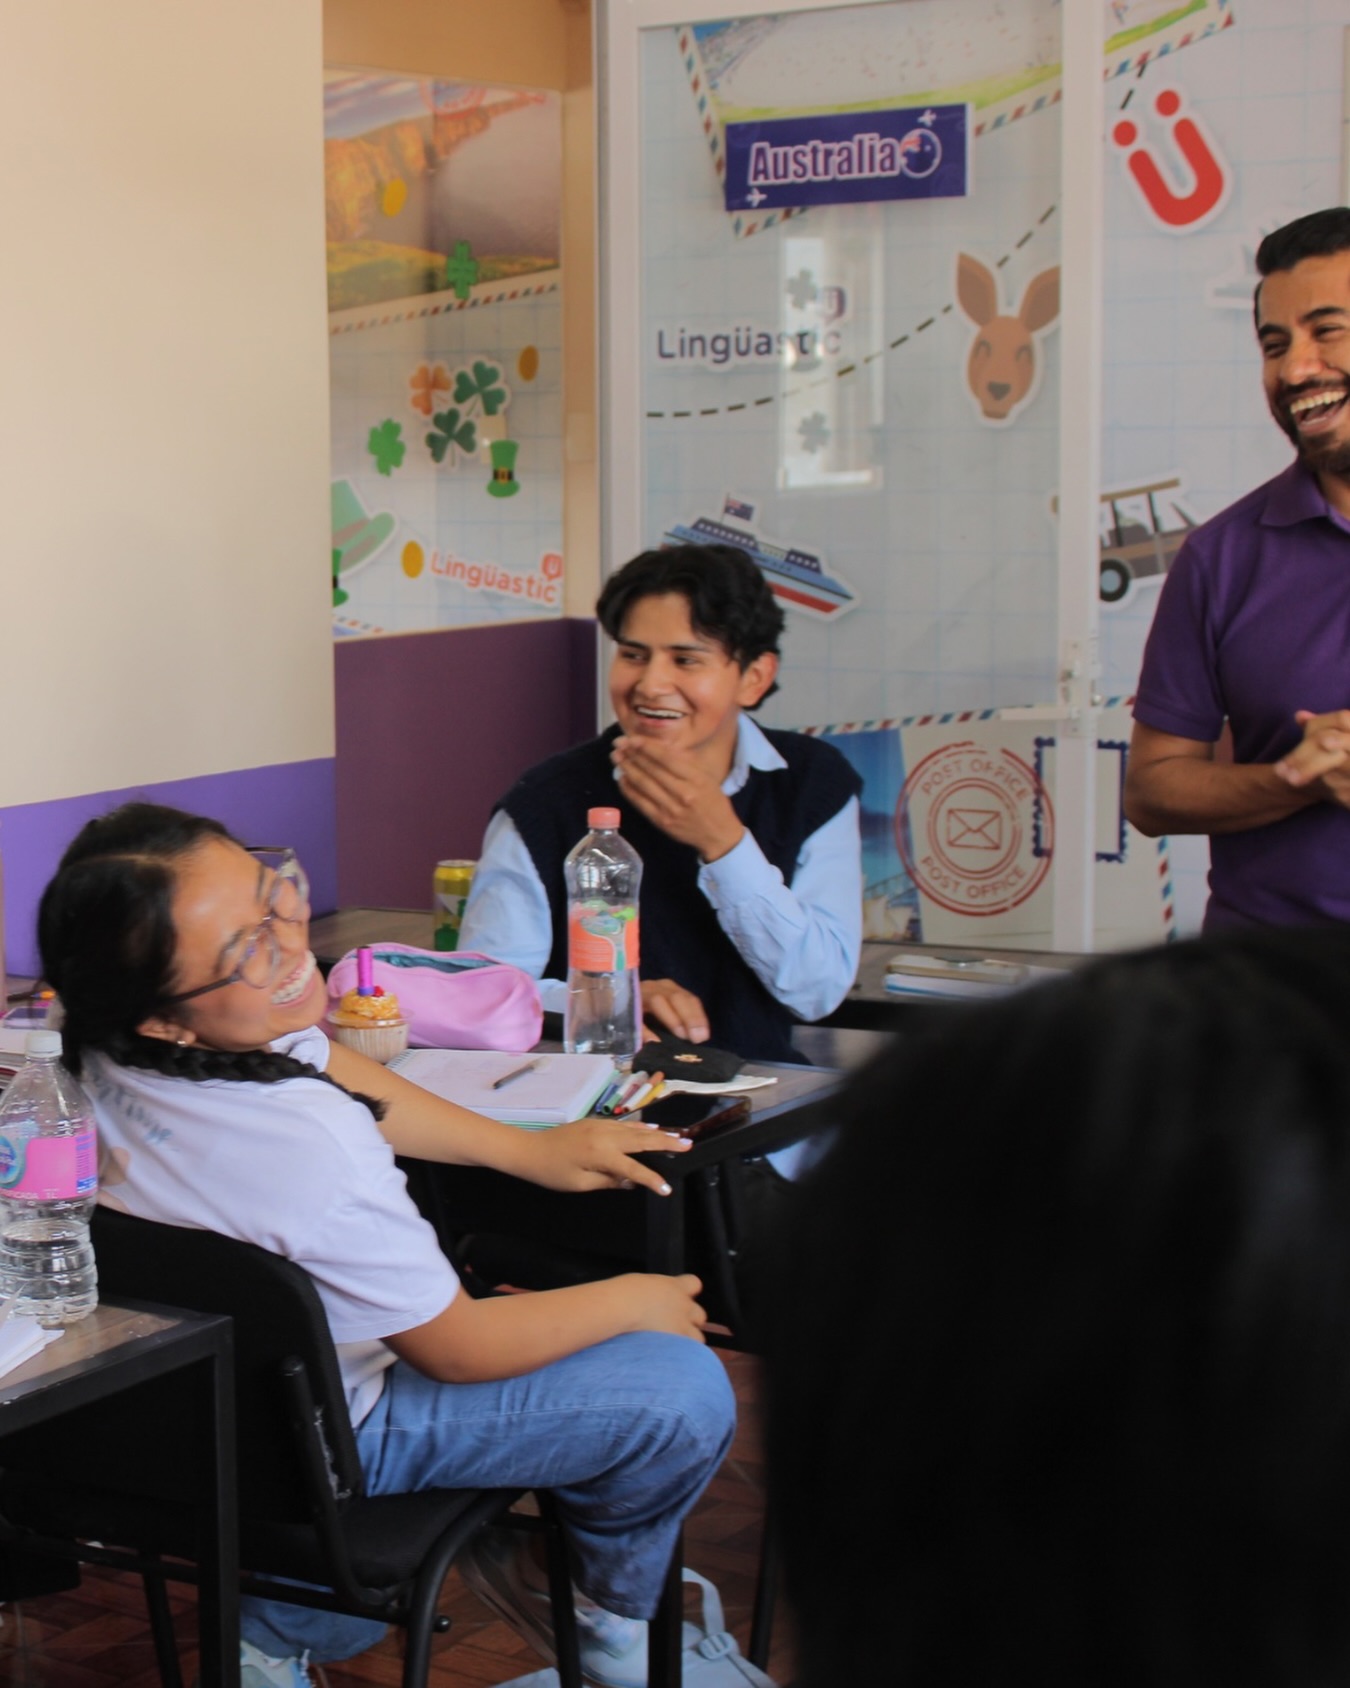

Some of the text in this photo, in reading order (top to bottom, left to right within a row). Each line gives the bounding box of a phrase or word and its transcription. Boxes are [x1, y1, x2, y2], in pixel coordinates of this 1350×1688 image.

[751, 135, 899, 184] Australia
[657, 326, 841, 365] Lingüastc
[430, 551, 556, 603] Lingüastic
[922, 758, 1030, 800] POST OFFICE
[921, 856, 1026, 899] POST OFFICE
